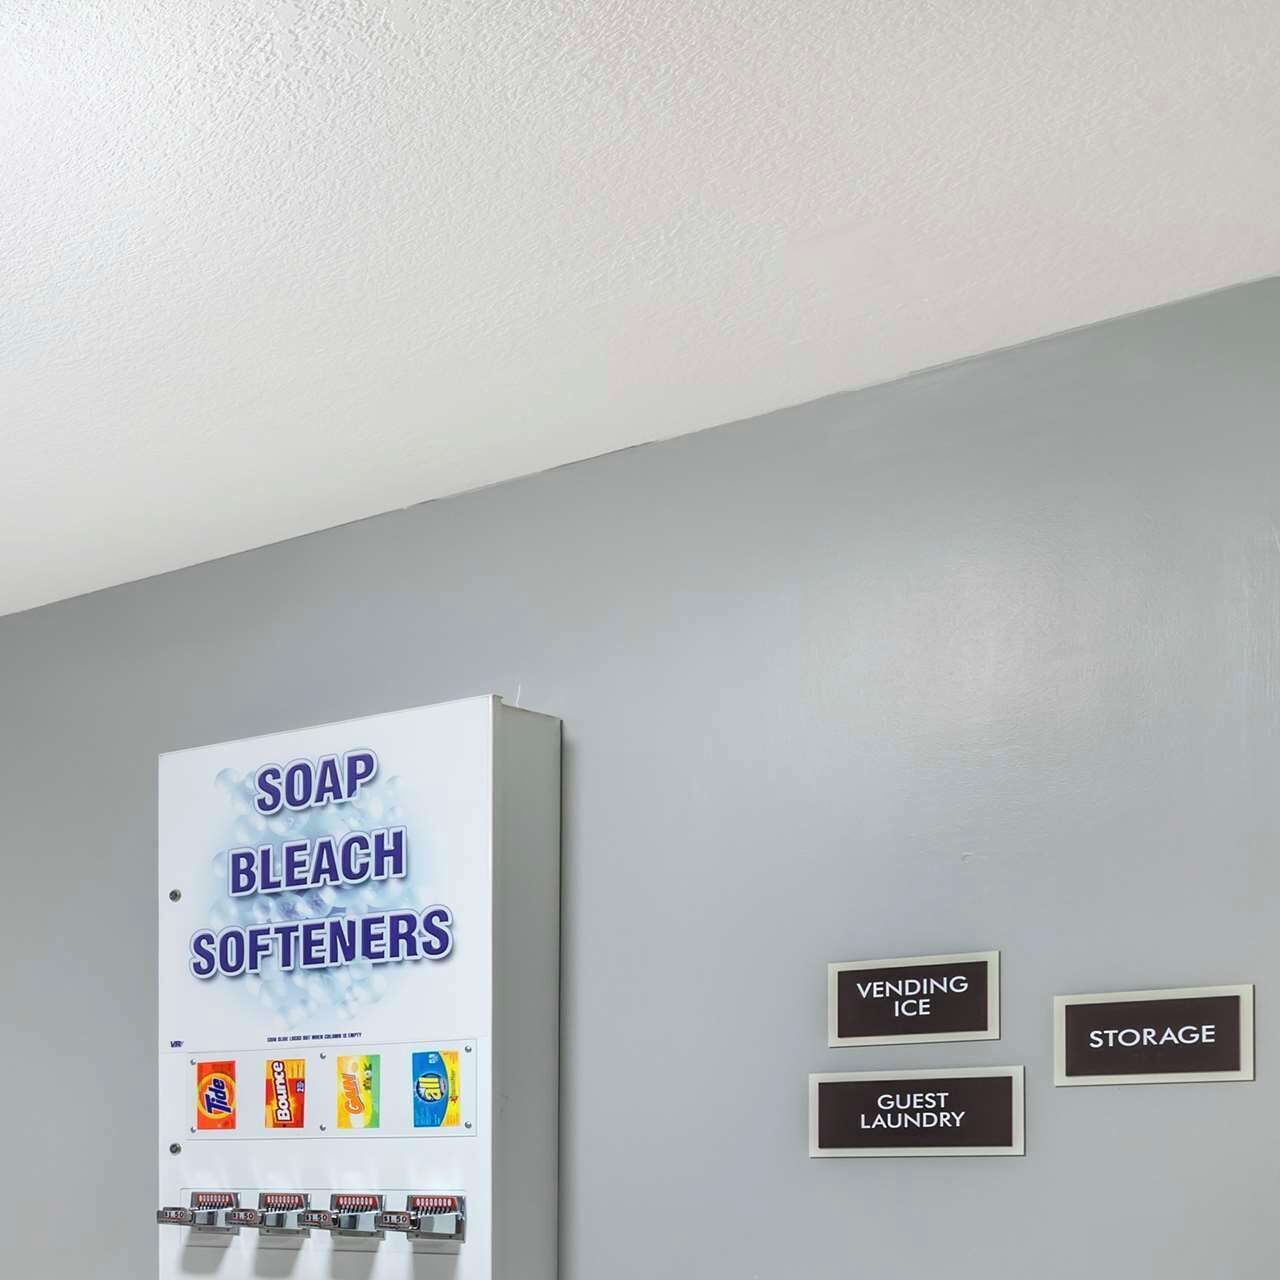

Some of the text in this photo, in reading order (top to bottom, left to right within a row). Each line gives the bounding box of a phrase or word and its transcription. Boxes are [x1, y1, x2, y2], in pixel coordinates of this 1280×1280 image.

[255, 750, 376, 813] SOAP
[229, 828, 405, 896] BLEACH
[191, 906, 451, 977] SOFTENERS
[856, 975, 969, 999] VENDING
[894, 999, 931, 1017] ICE
[1089, 1025, 1216, 1048] STORAGE
[205, 1078, 232, 1114] Tide
[272, 1061, 292, 1121] Bounce
[419, 1077, 442, 1101] all
[877, 1092, 949, 1111] GUEST
[860, 1111, 966, 1130] LAUNDRY
